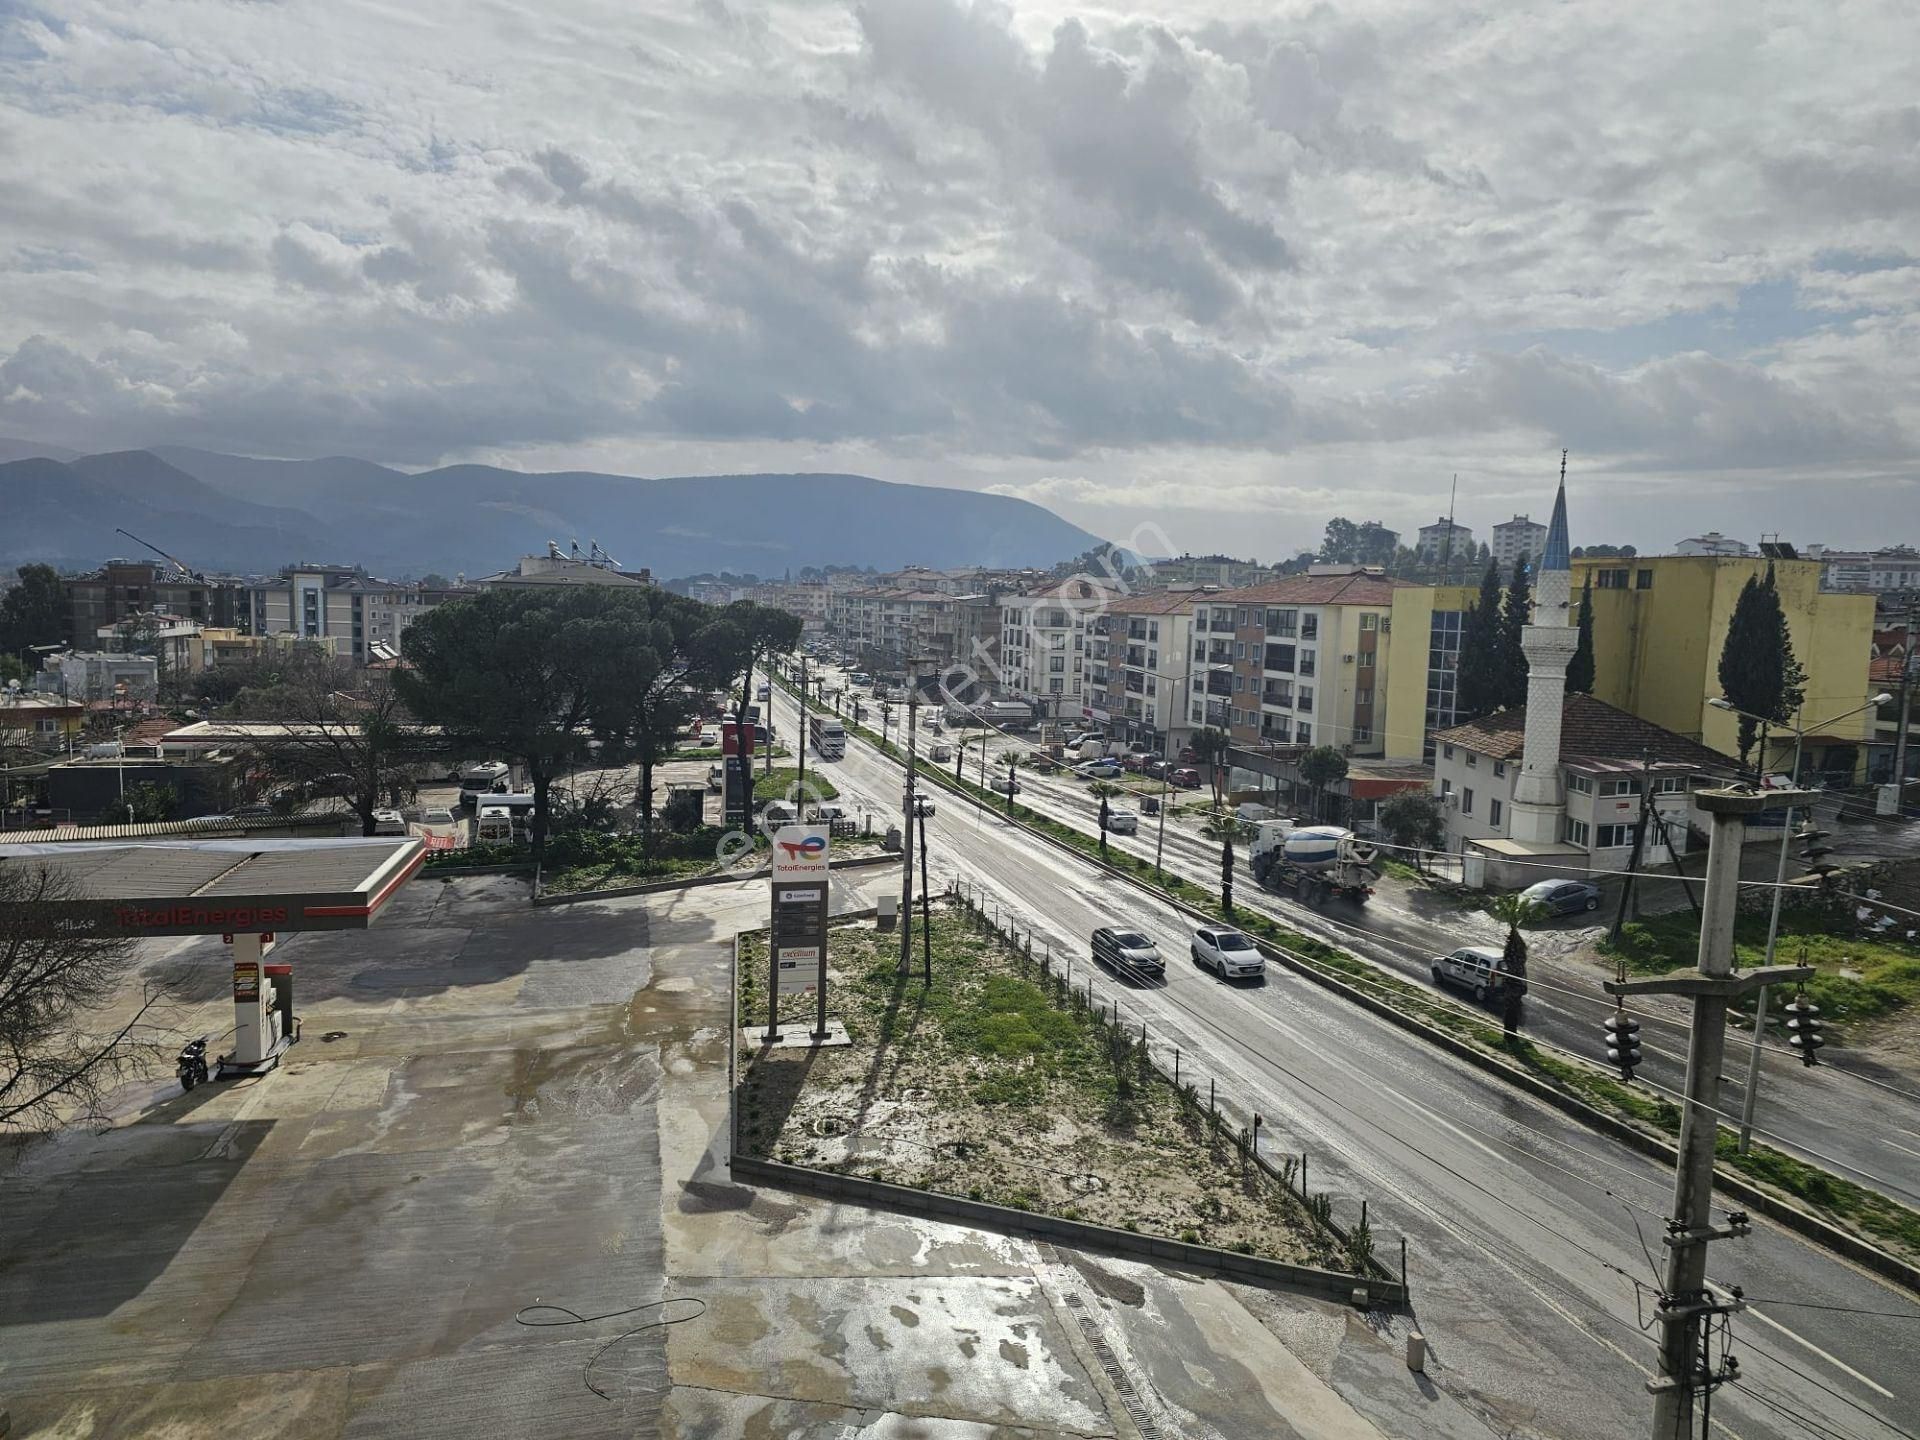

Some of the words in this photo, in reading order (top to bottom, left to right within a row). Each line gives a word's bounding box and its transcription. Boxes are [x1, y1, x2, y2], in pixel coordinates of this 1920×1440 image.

[777, 864, 826, 872] TotalEnergies
[113, 904, 288, 929] TotalEnergies
[225, 935, 232, 943] 2
